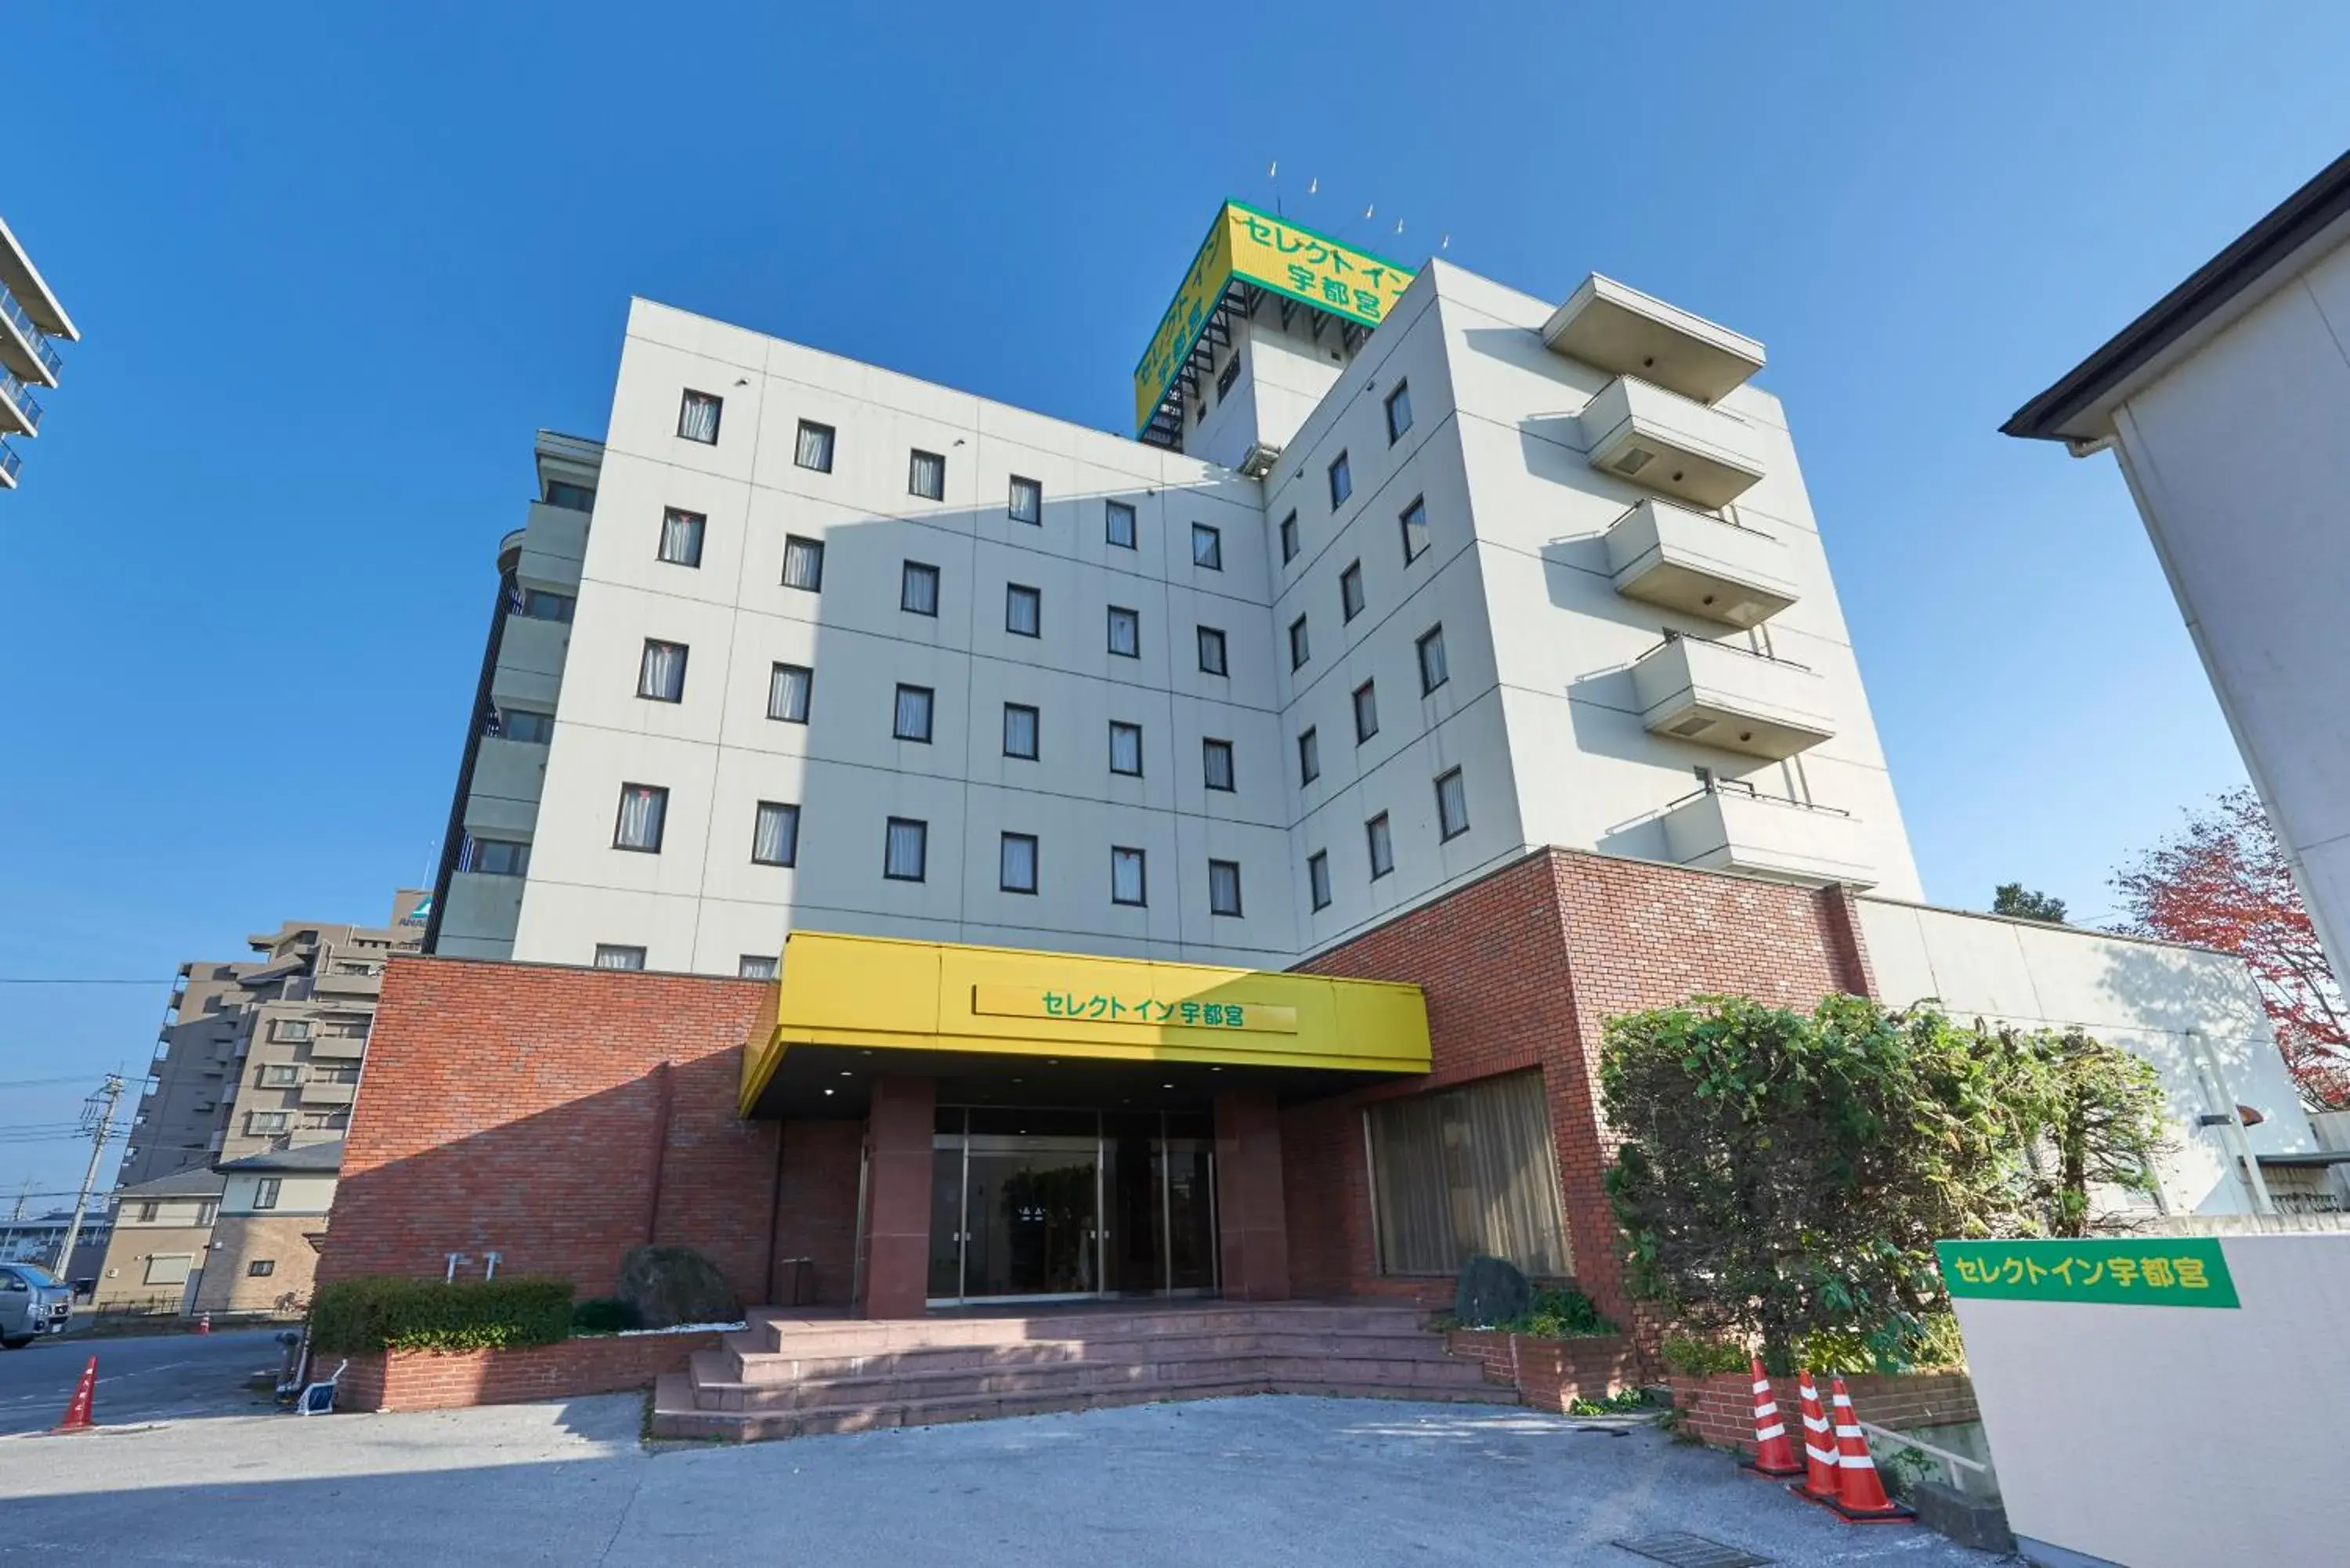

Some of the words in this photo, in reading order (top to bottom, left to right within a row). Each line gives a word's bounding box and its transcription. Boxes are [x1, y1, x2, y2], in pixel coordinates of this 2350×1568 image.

[1287, 262, 1380, 319] 宇都宮
[1043, 992, 1244, 1027] セレクトイン宇都宮
[1955, 1256, 2209, 1288] セレクトイン宇都宮
